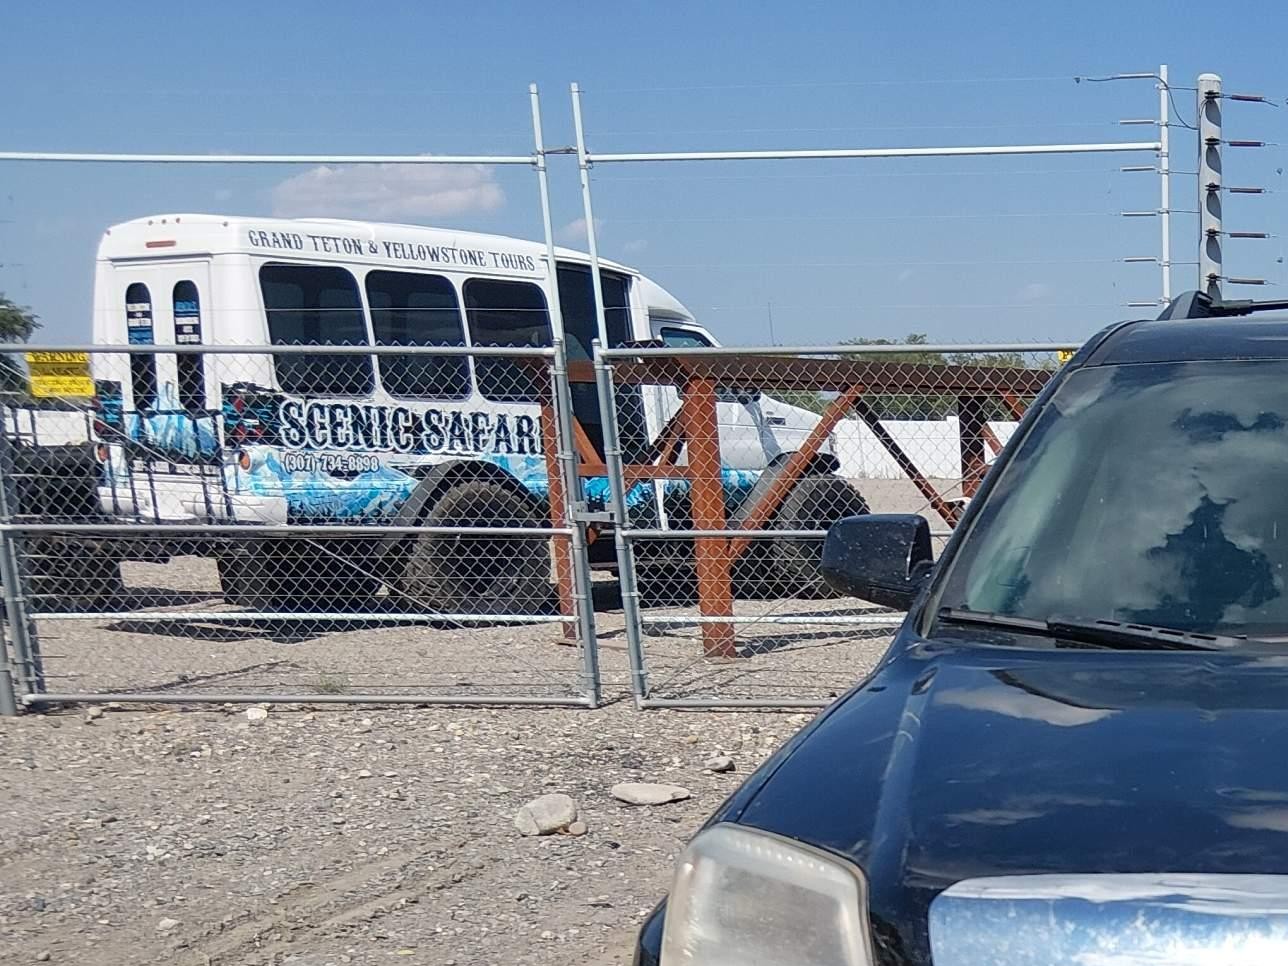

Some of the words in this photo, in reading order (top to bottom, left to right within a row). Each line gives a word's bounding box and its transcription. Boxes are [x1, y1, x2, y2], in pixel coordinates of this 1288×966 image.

[248, 229, 303, 250] GRAND
[307, 234, 364, 255] TETON
[368, 241, 378, 254] &
[382, 241, 487, 267] YELLOWSTONE
[488, 251, 535, 271] TOURS
[280, 399, 414, 451] SCENIC
[284, 452, 317, 474] (307)
[320, 453, 380, 473] 734-8898
